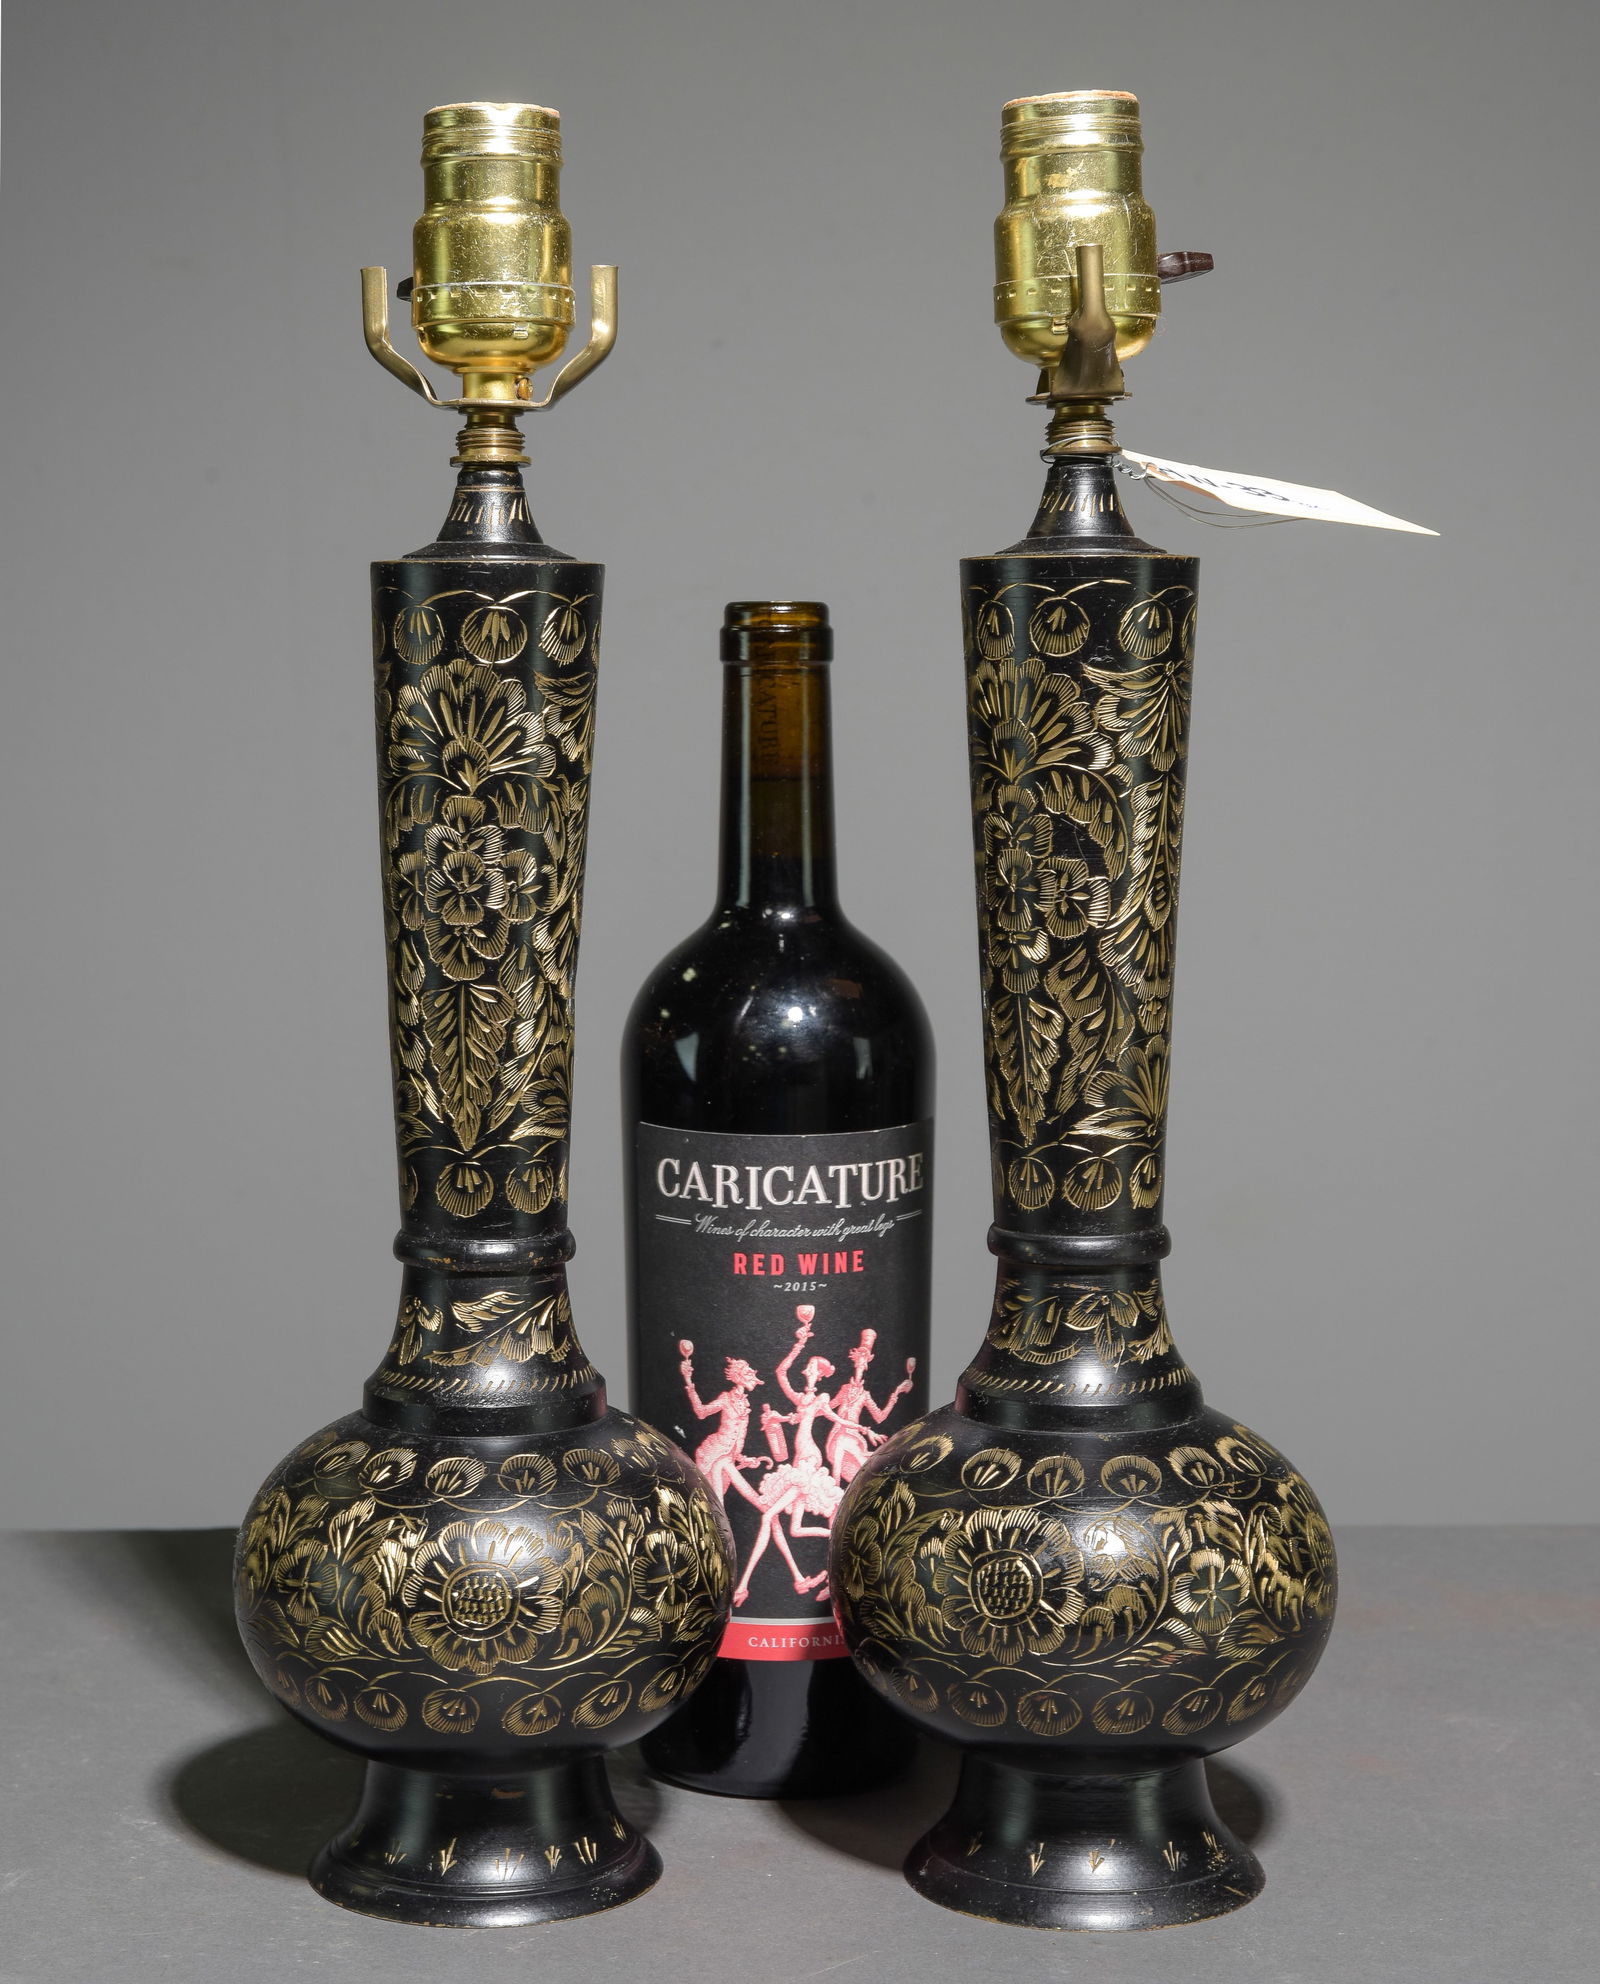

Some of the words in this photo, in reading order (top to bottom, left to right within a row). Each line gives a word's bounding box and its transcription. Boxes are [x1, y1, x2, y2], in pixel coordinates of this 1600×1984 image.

[656, 1152, 924, 1211] CARICATURE
[695, 1213, 735, 1236] Wines
[734, 1219, 757, 1242] of
[750, 1219, 811, 1238] character
[812, 1217, 842, 1238] with
[838, 1219, 876, 1242] great
[874, 1213, 895, 1238] legs
[733, 1252, 785, 1276] RED
[797, 1249, 865, 1276] WINE
[747, 1634, 845, 1649] CALIFORNI
